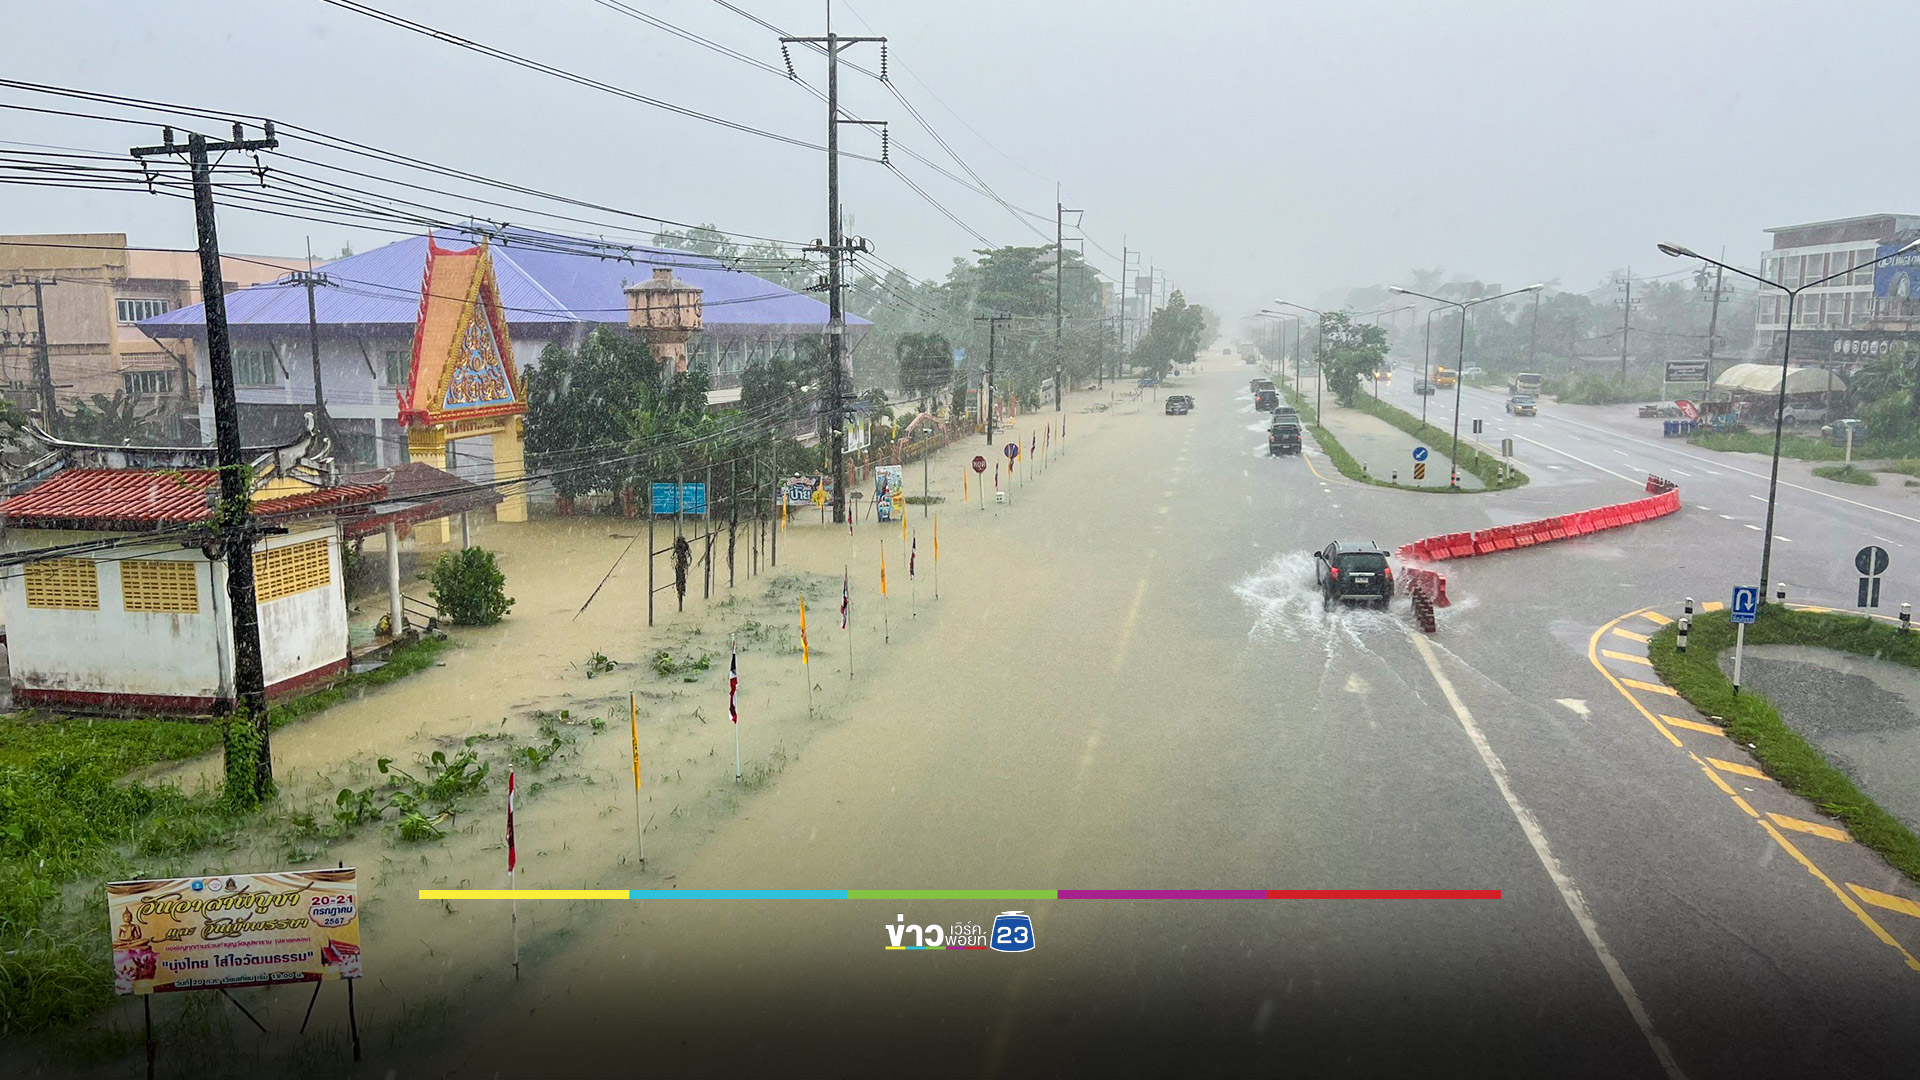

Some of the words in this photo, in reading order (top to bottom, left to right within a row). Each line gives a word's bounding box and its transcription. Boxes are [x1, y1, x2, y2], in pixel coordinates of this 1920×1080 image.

[311, 894, 353, 906] 20-21
[312, 906, 353, 917] กรกฎาคม
[324, 917, 345, 925] 2567
[151, 926, 197, 943] และ
[201, 912, 309, 941] วันเข้าพรรษา
[162, 957, 209, 974] "นุ่งไทย
[214, 951, 314, 968] ใส่ใจวัฒนธรรม"
[271, 972, 294, 980] 19.00
